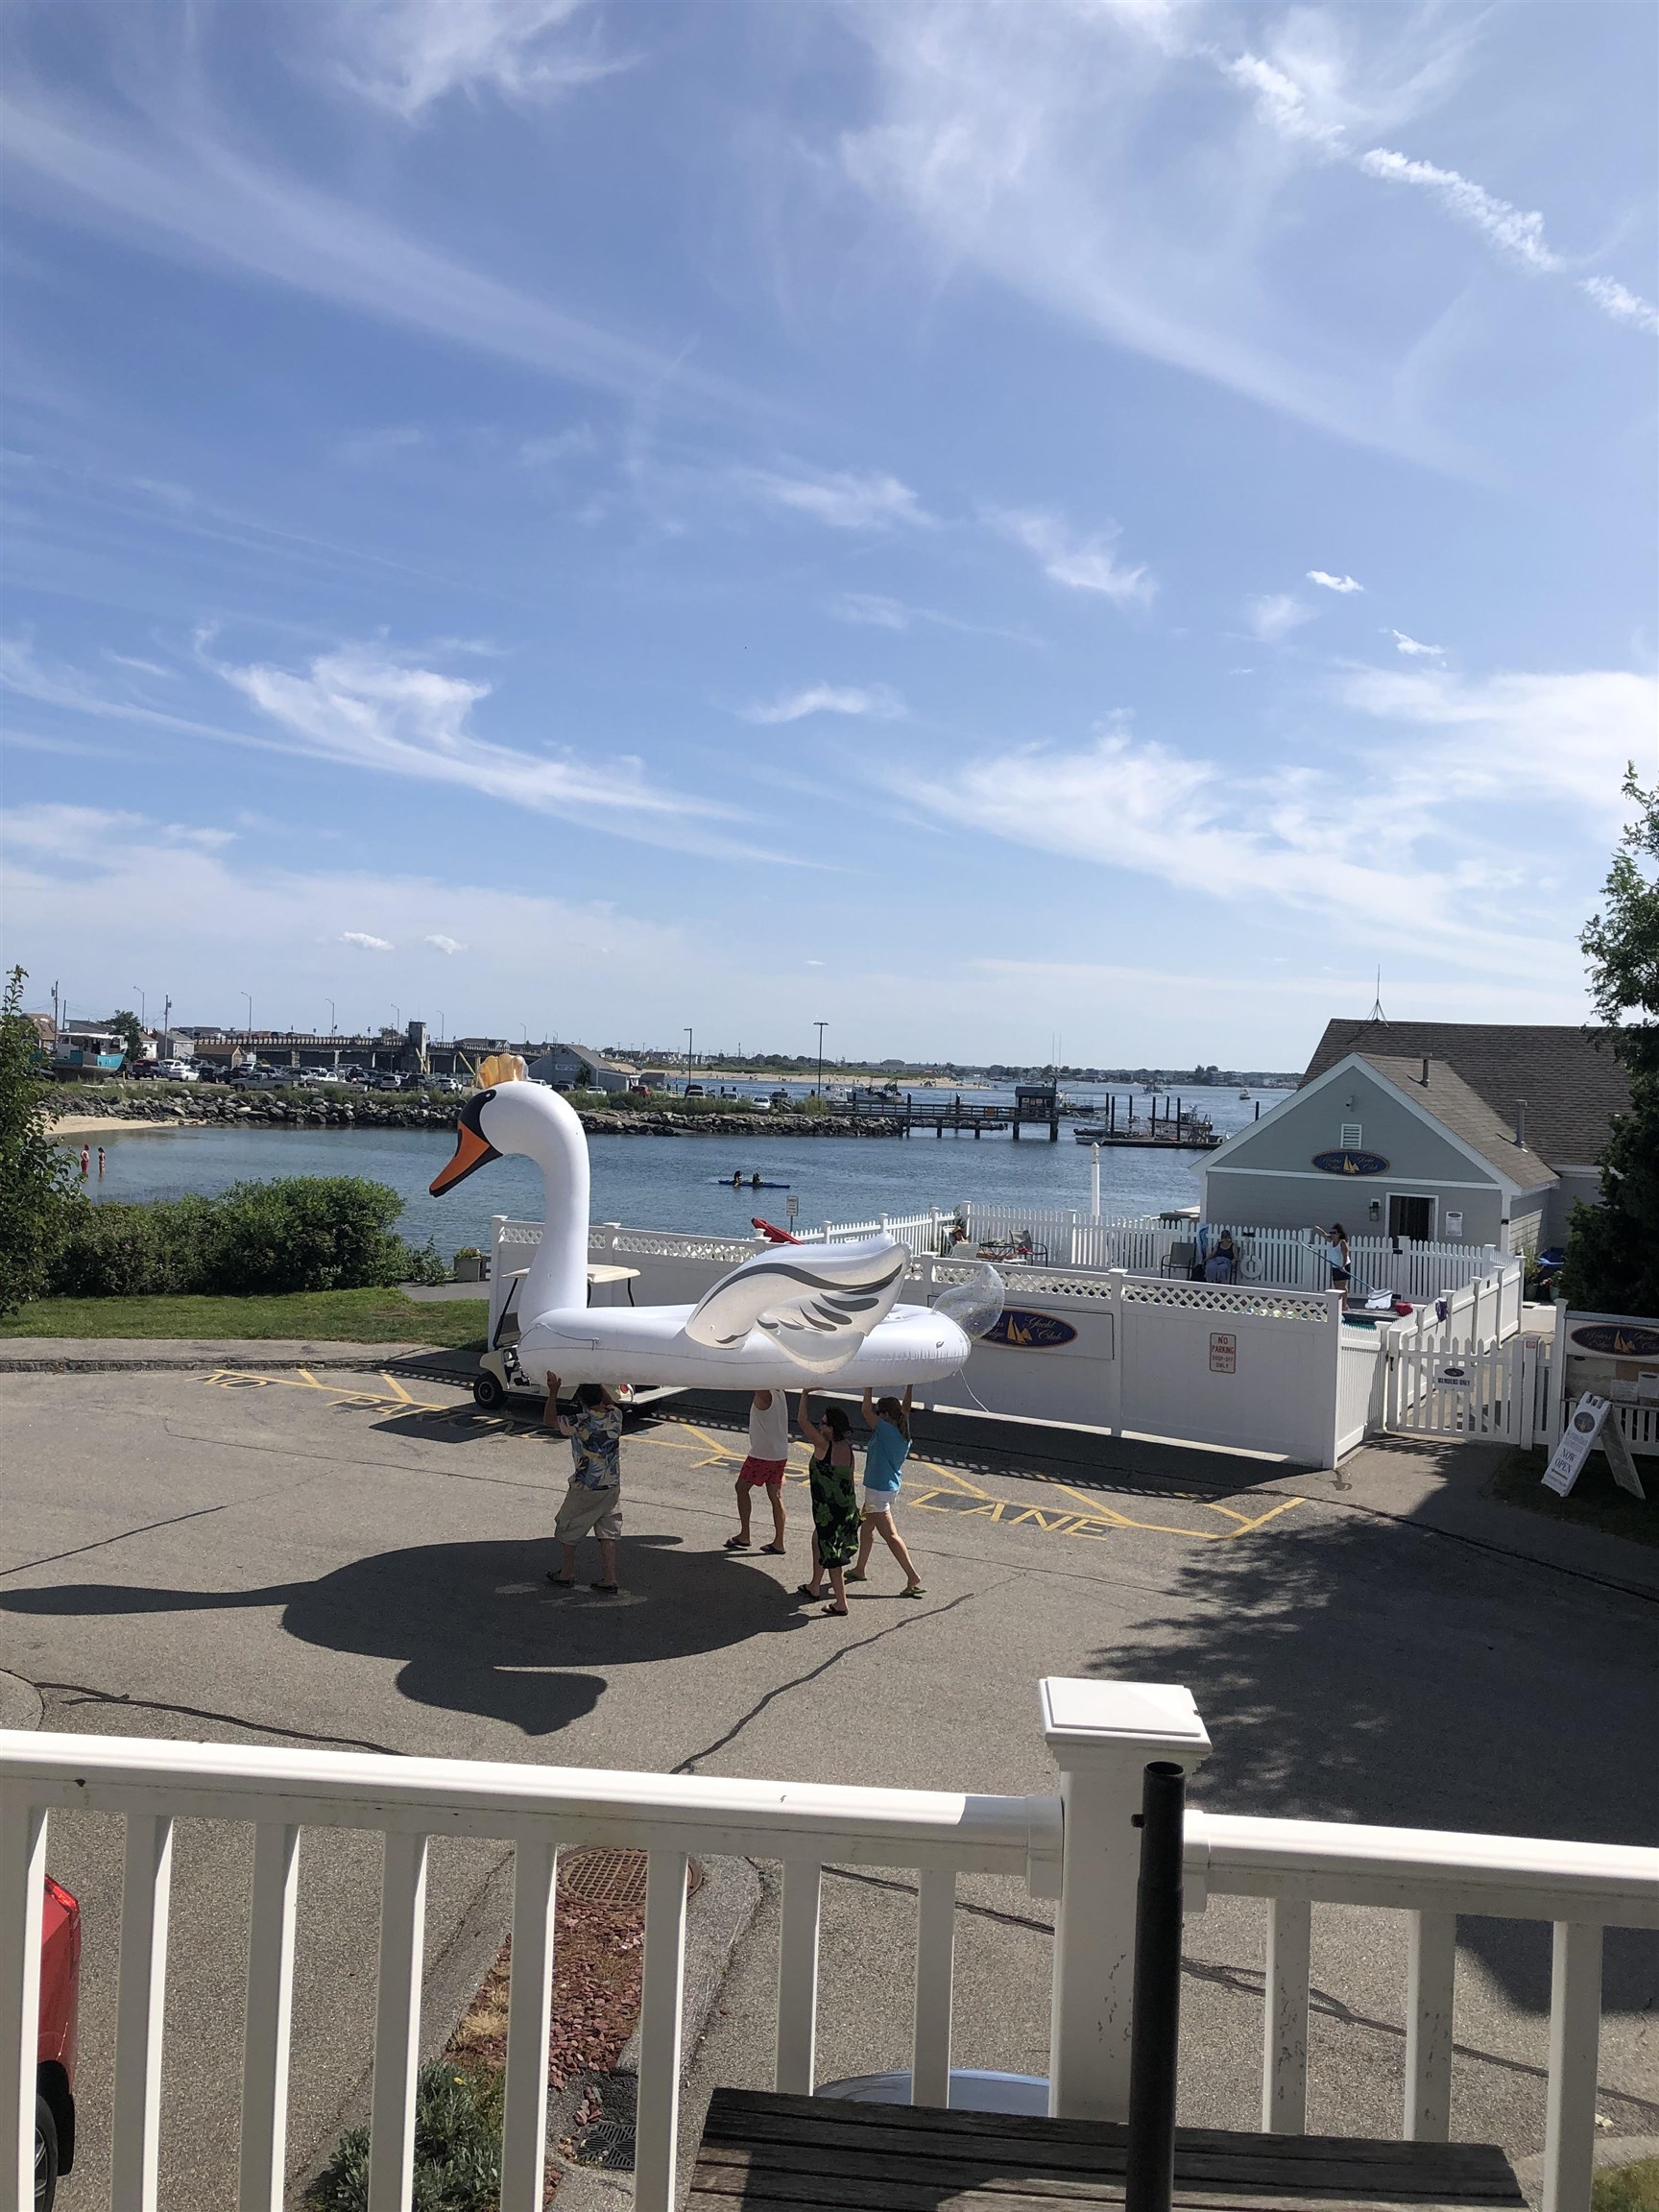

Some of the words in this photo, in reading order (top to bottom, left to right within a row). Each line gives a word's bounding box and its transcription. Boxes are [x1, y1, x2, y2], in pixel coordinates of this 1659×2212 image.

[1022, 1315, 1057, 1330] Yacht
[1036, 1329, 1062, 1340] Club
[1217, 1335, 1229, 1345] NO
[1212, 1345, 1235, 1355] PARKING
[185, 1369, 268, 1390] NO
[1562, 1448, 1576, 1461] NOW
[1554, 1458, 1572, 1474] OPEN
[907, 1490, 1108, 1541] LANE
